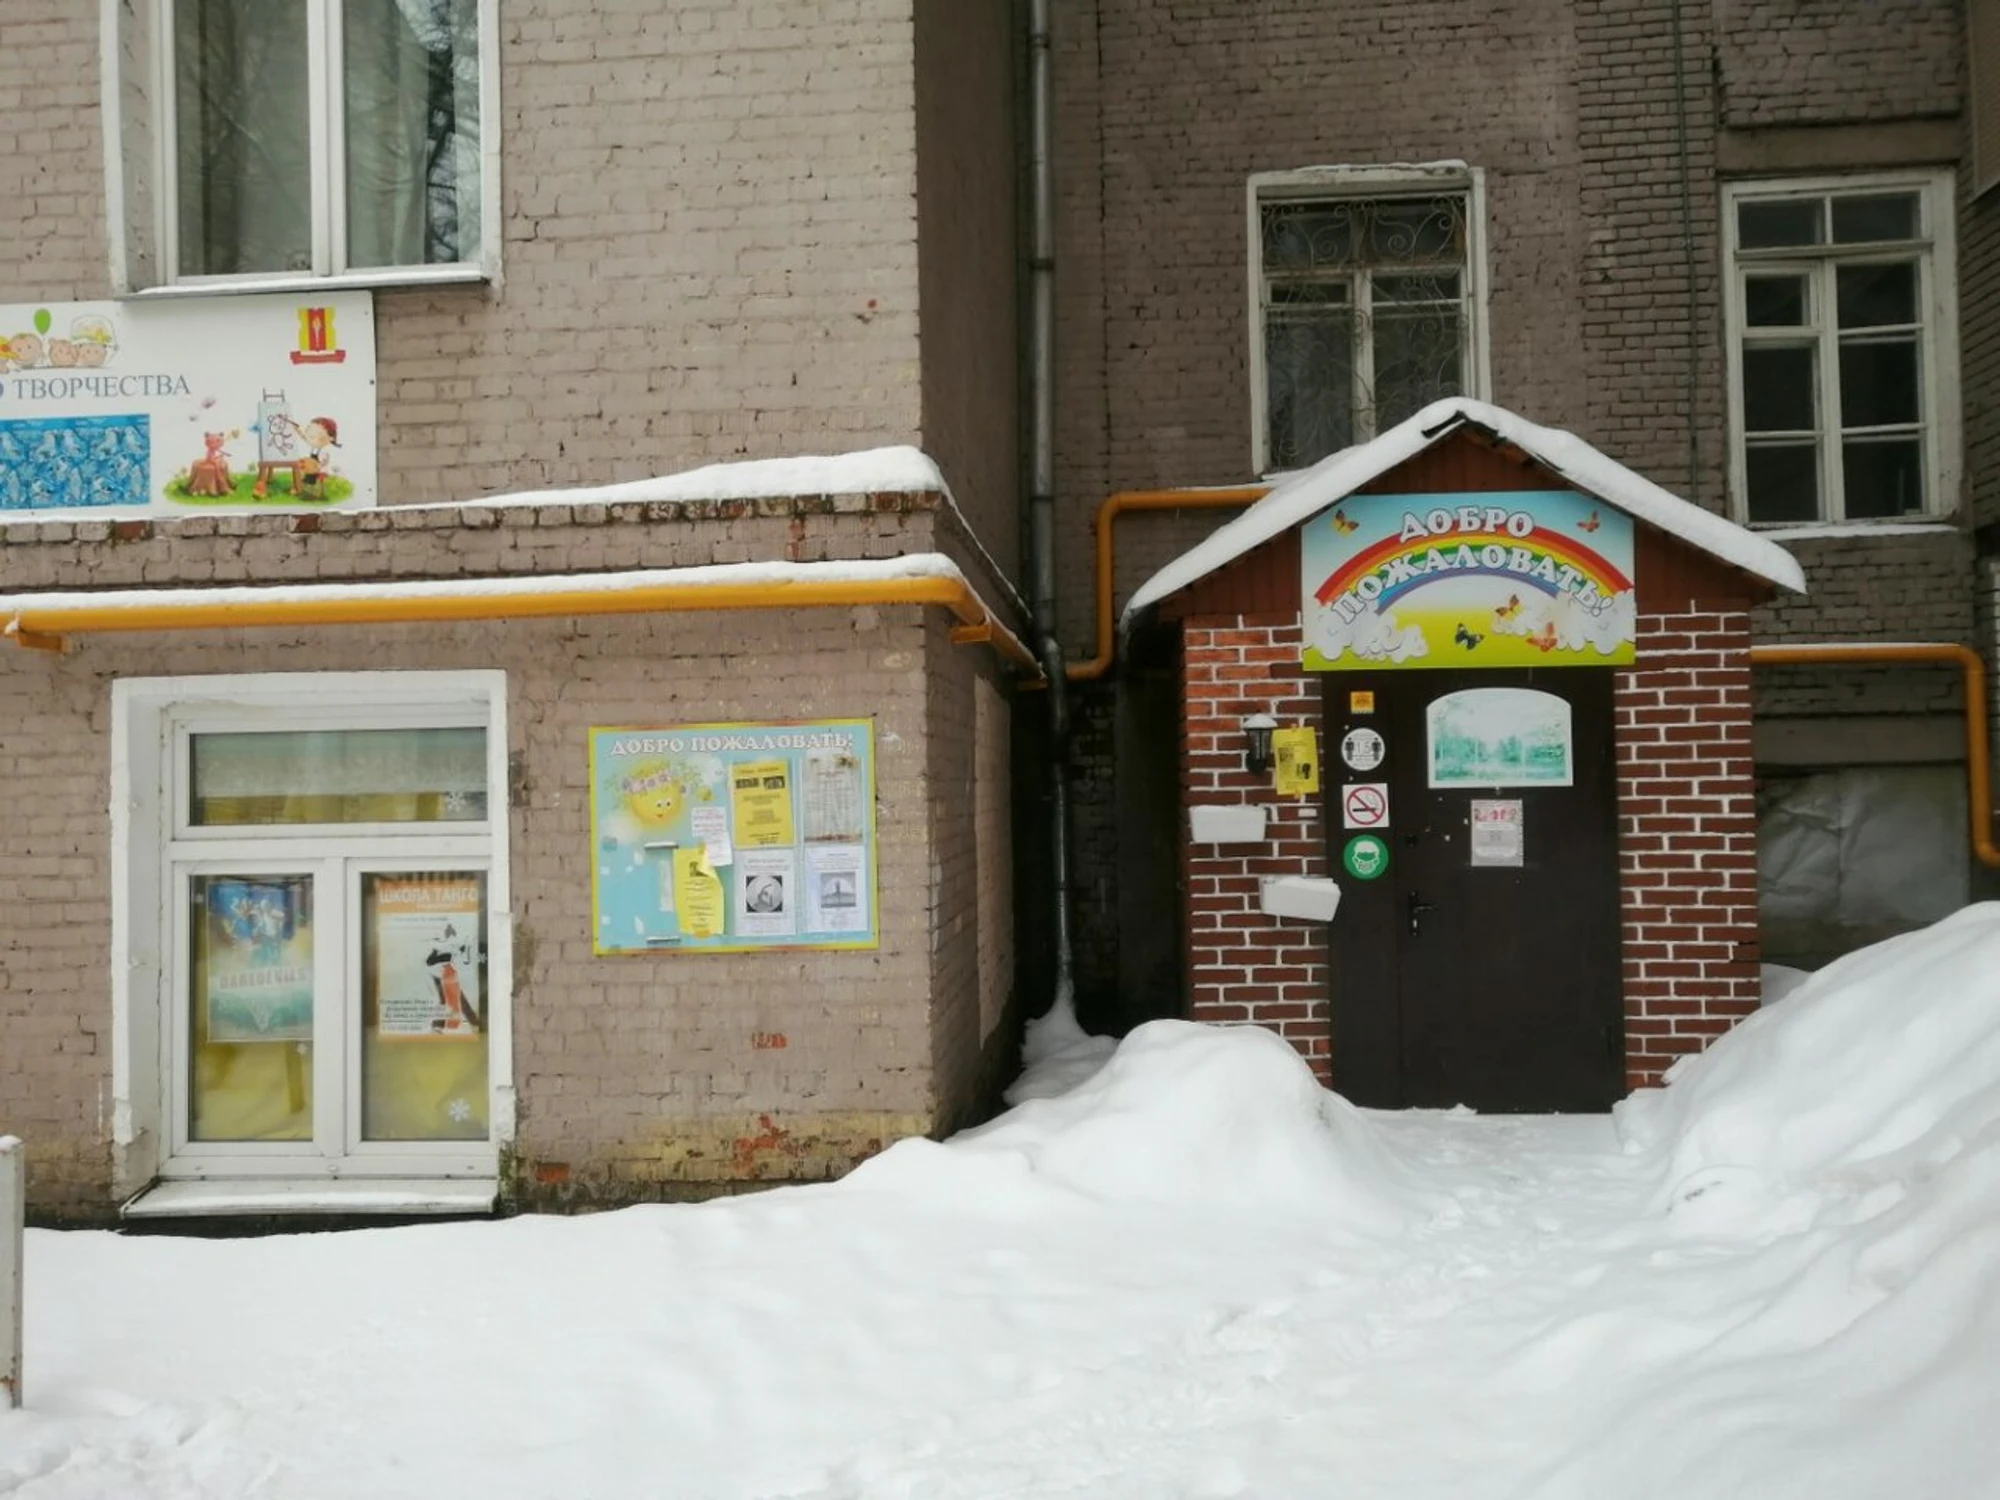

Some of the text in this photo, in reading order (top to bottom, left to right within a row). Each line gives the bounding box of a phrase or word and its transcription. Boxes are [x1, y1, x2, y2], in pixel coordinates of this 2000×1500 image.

[12, 375, 191, 400] ТВОРЧЕСТВА
[1400, 506, 1534, 543] ДОБРО
[1331, 543, 1614, 625] ПОЖАЛОВАТЬ!
[611, 732, 854, 756] ДОБРО ПОЖАЛОВАТЬ!
